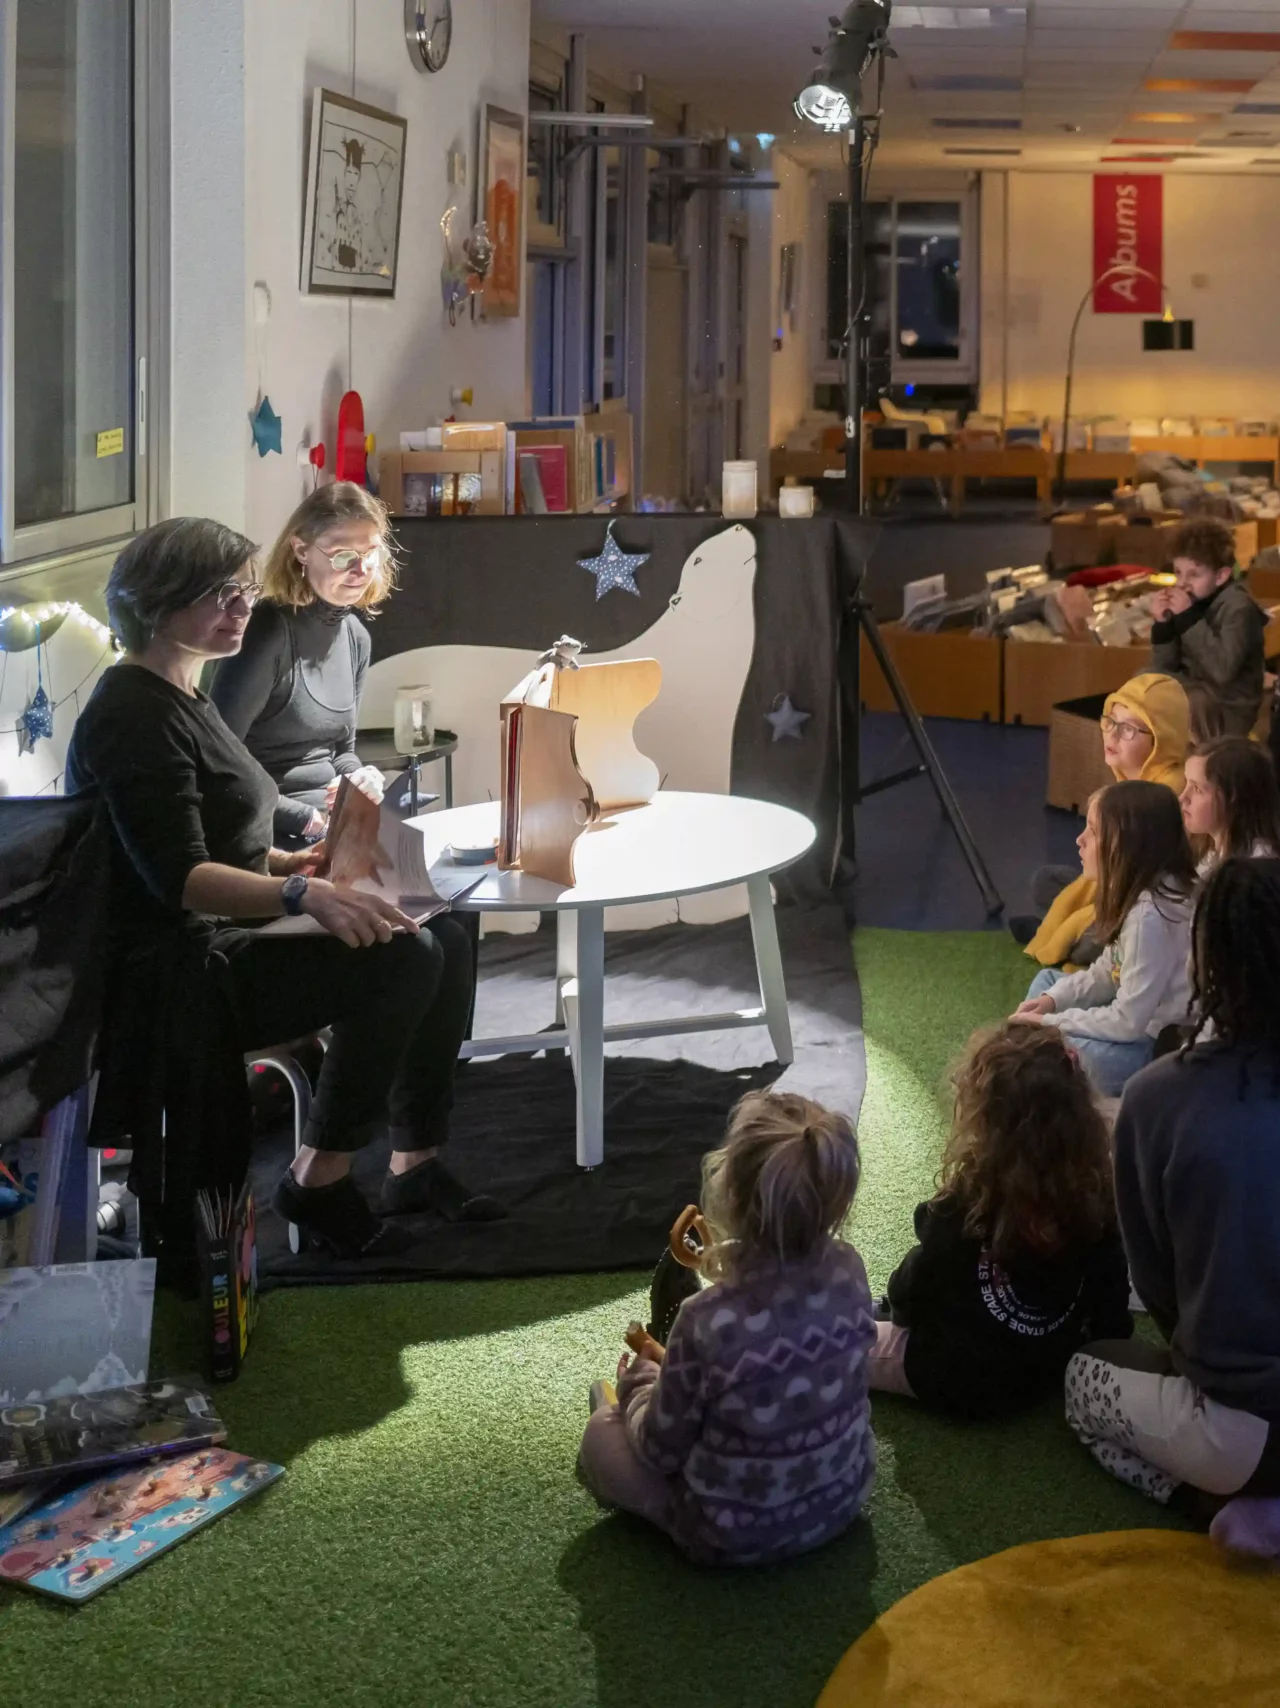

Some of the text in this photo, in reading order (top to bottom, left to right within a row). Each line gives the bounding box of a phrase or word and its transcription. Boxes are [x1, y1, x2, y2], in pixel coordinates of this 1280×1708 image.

[1109, 184, 1138, 302] Albums
[980, 1283, 1008, 1322] STADE
[1007, 1317, 1045, 1336] STADE
